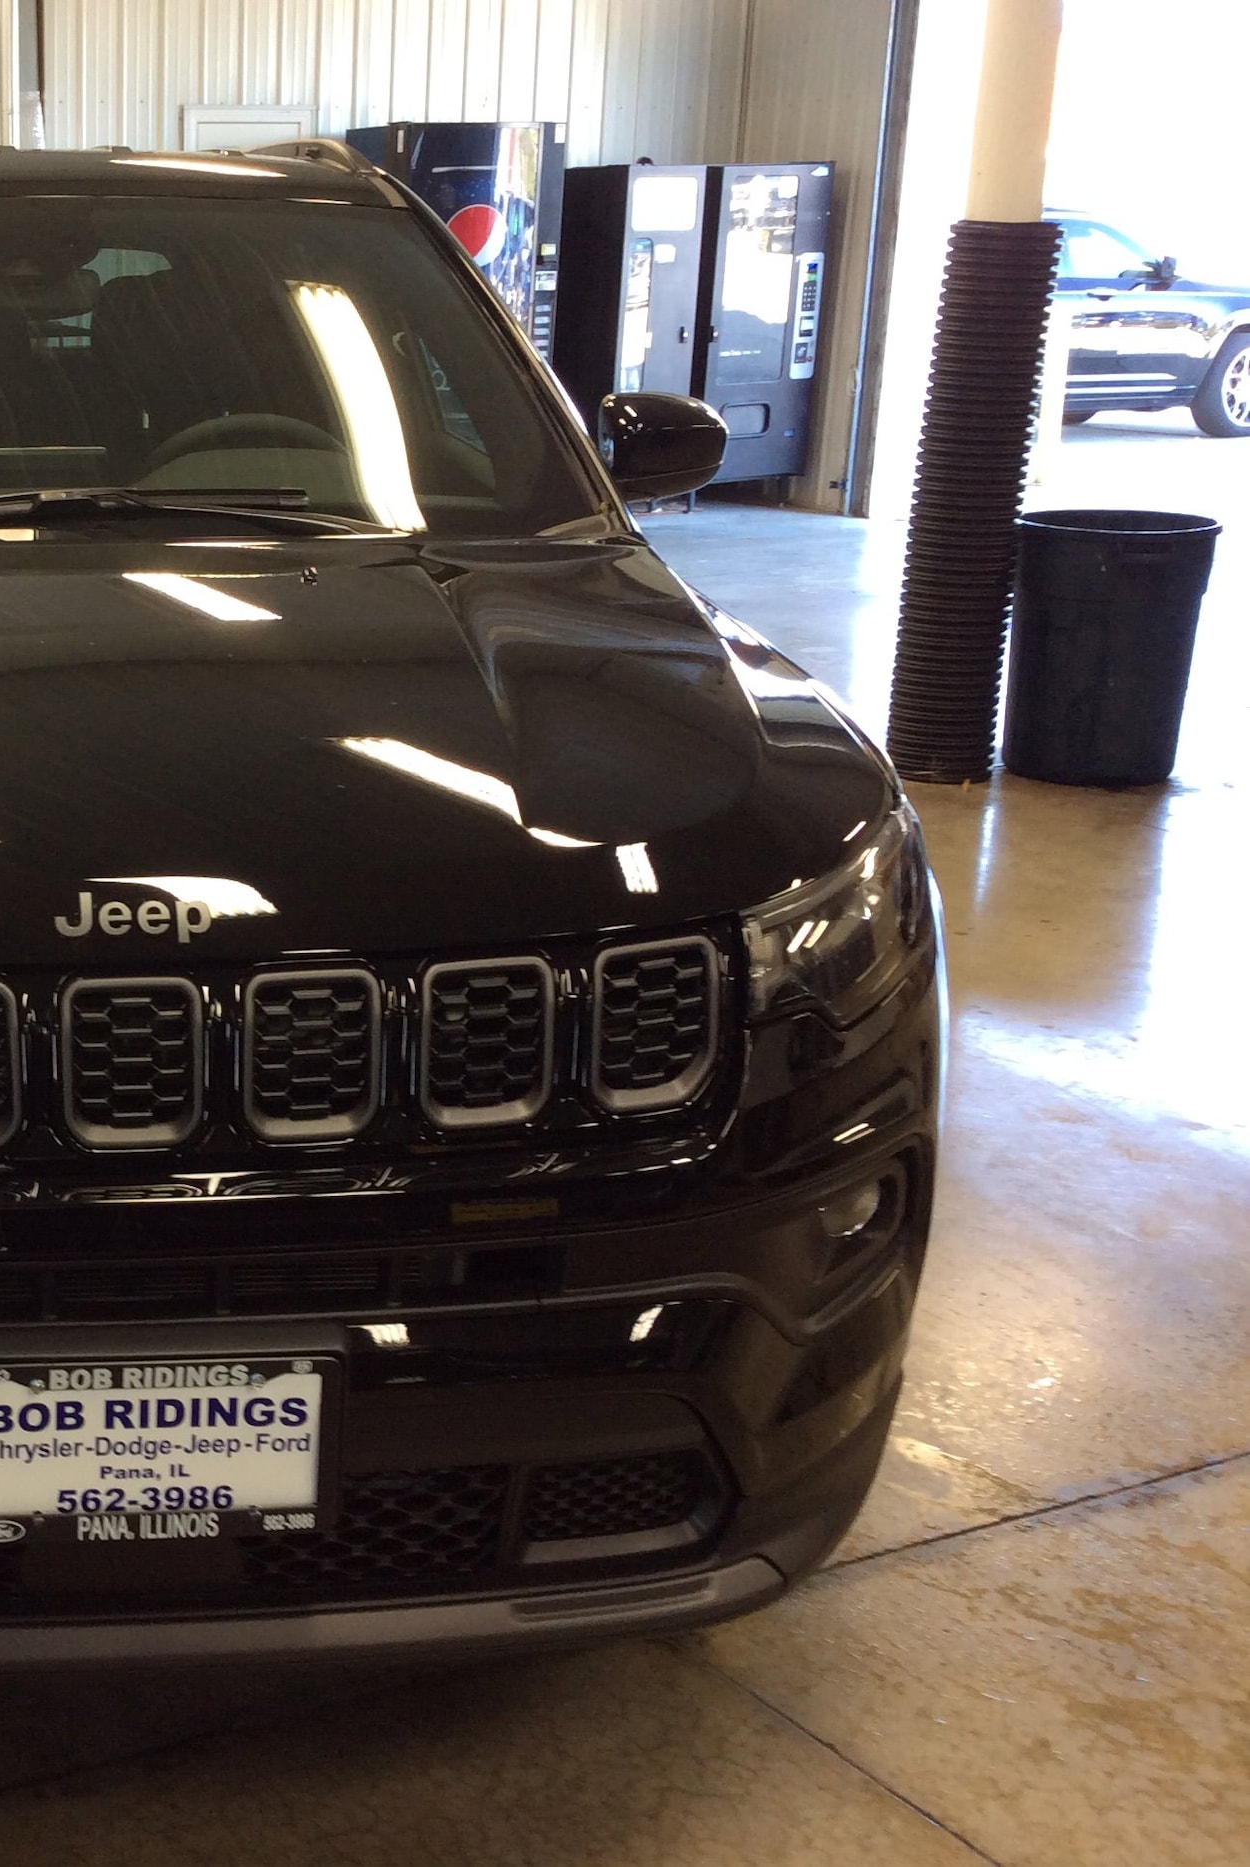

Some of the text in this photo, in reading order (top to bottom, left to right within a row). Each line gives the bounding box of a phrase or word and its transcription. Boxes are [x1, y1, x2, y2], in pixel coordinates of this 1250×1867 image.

[54, 892, 212, 943] Jeep
[49, 1364, 249, 1390] BOB RIDINGS
[105, 1397, 308, 1429] RIDINGS
[100, 1464, 190, 1480] Pana, IL
[57, 1485, 233, 1513] 562-3986
[139, 1512, 220, 1539] ILLINOIS
